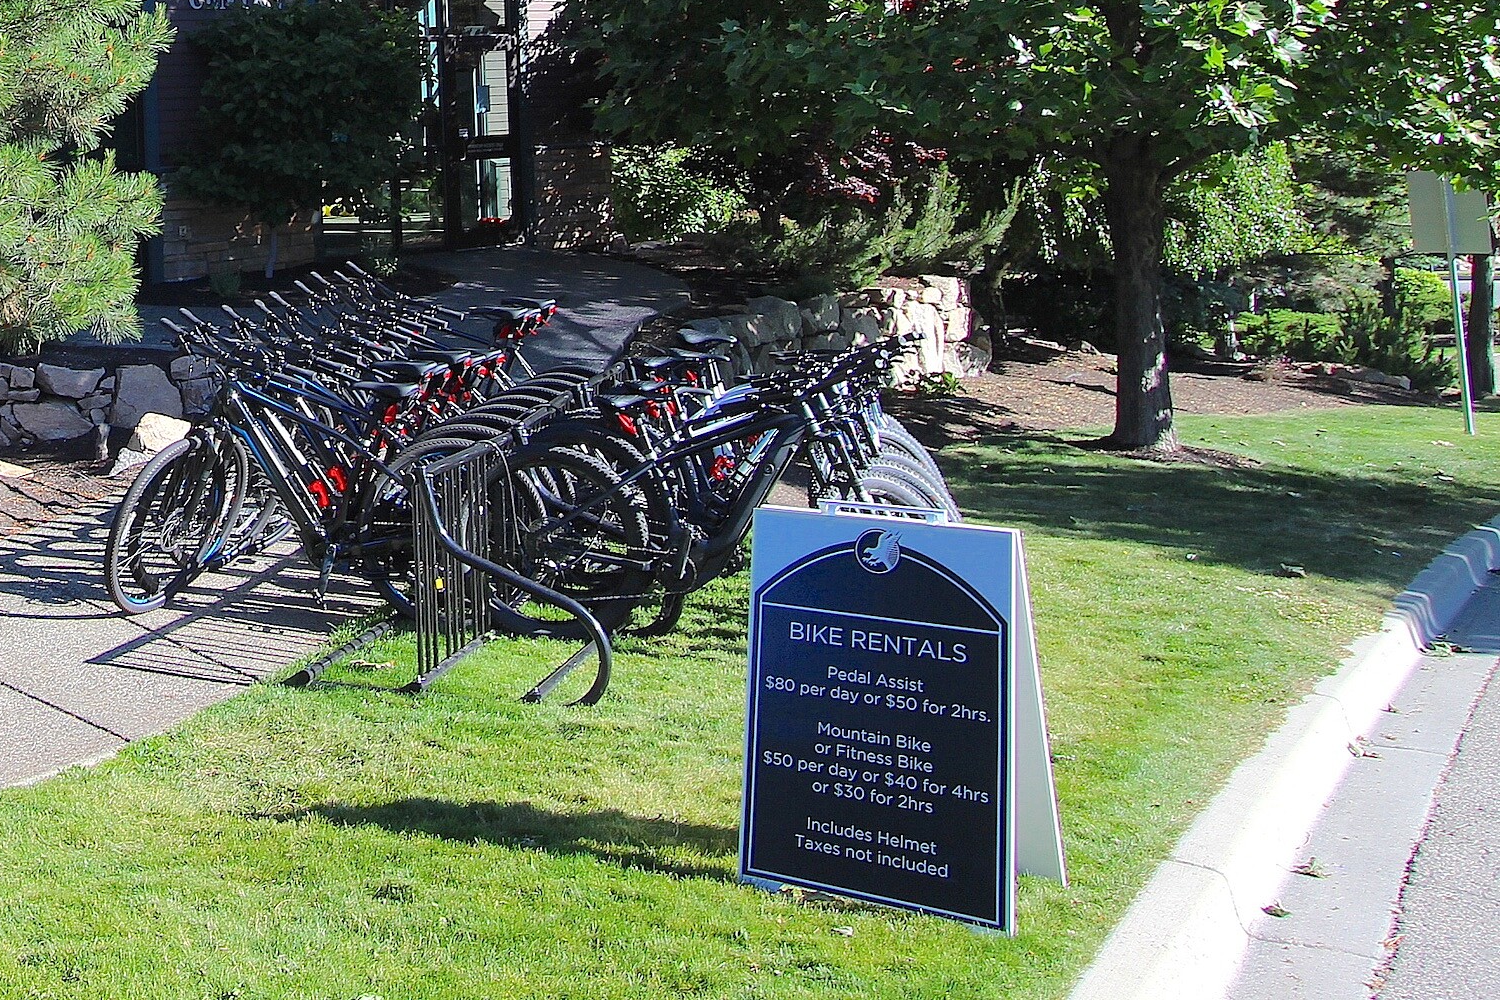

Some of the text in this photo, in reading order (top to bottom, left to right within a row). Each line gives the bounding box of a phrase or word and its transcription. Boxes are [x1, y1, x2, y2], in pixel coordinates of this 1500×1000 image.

[789, 621, 968, 663] BIKE RENTALS
[765, 675, 992, 723] $80 per day or $50 for 2hrs.
[827, 666, 924, 693] Pedal Assist
[817, 721, 932, 753] Mountain Bike
[763, 750, 989, 803] $50 per day or $40 for 4hrs
[814, 743, 933, 773] or Fitness Bike
[812, 781, 934, 813] or $30 for 2hrs
[806, 816, 937, 855] Includes Helmet
[795, 833, 948, 878] Taxes not included
